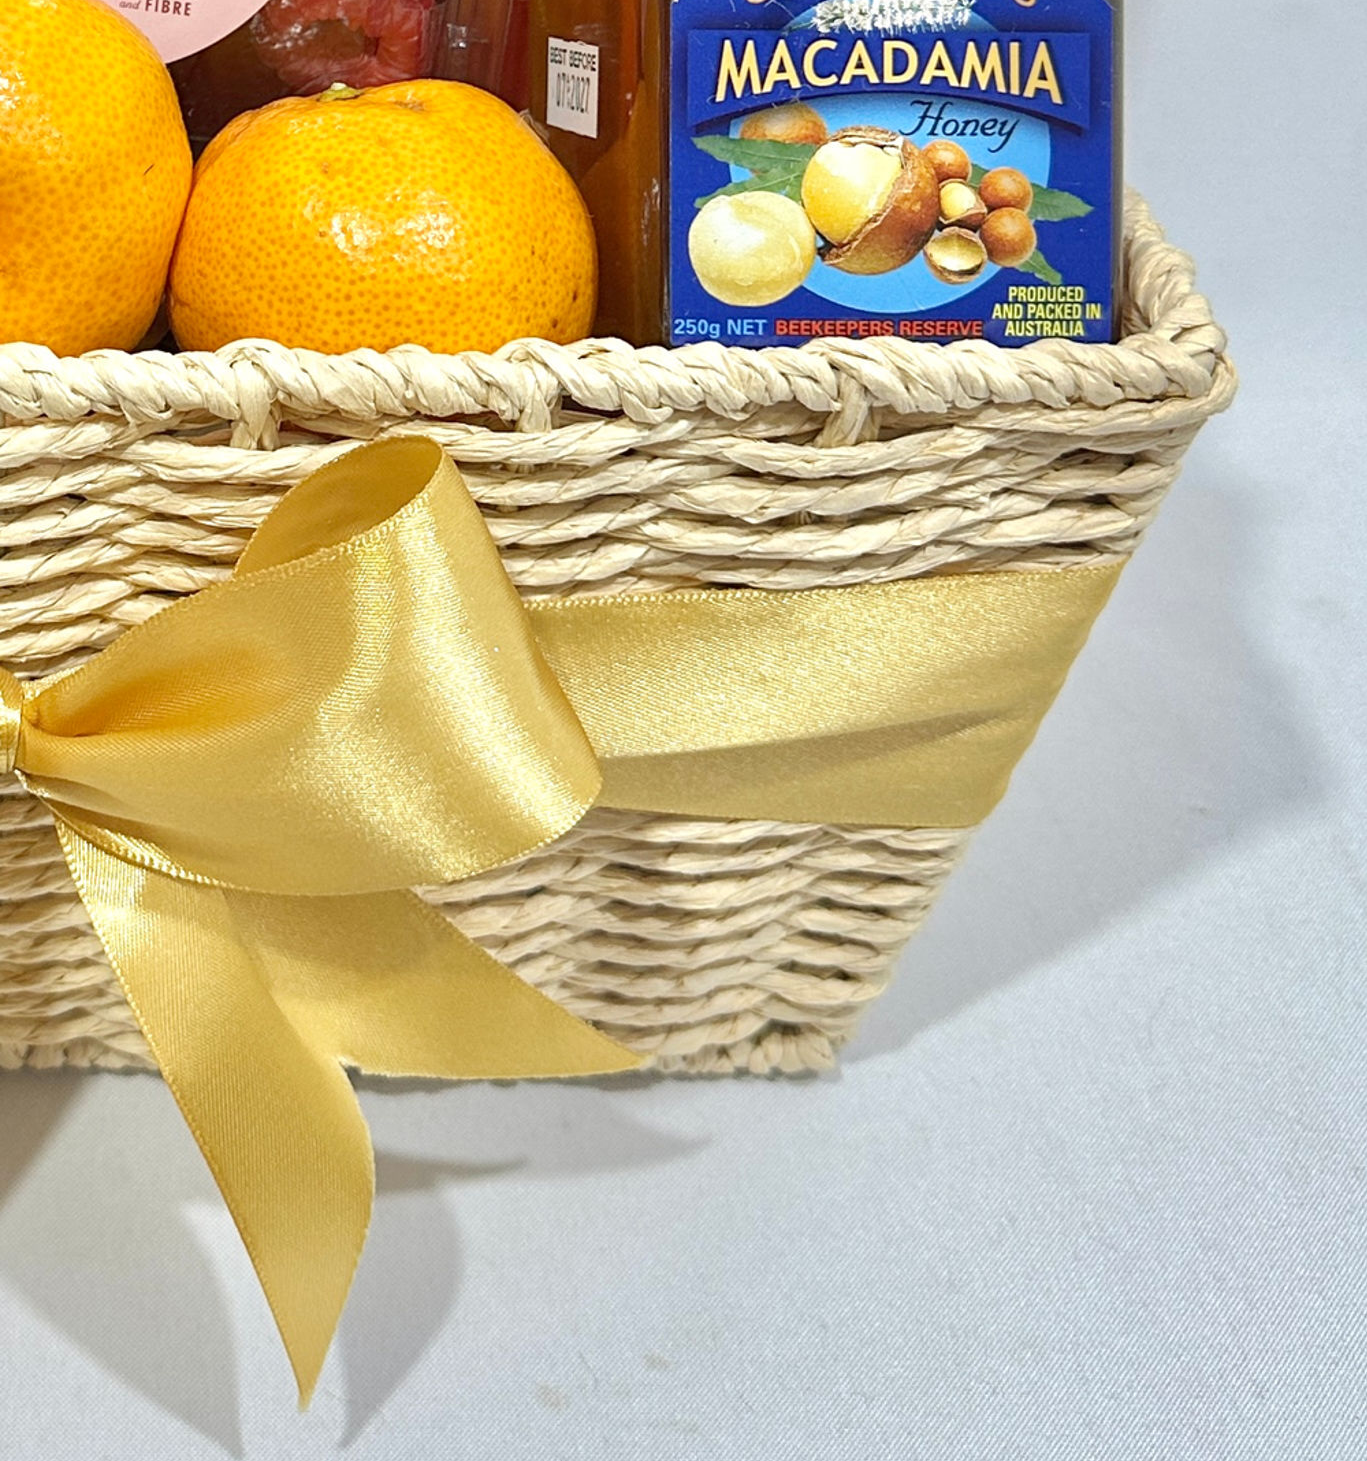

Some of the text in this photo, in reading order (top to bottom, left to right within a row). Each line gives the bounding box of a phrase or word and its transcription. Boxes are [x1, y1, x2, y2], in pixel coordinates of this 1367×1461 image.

[119, 0, 141, 10] and
[714, 39, 1063, 105] MACADAMIA
[899, 101, 1020, 153] Honey
[1008, 286, 1085, 302] PRODUCED
[992, 303, 1102, 319] AND PACKED IN
[674, 318, 768, 339] 250g NET
[775, 319, 984, 337] BEEKEEPERS RESERVE
[1004, 320, 1086, 337] AUSTRALIA
